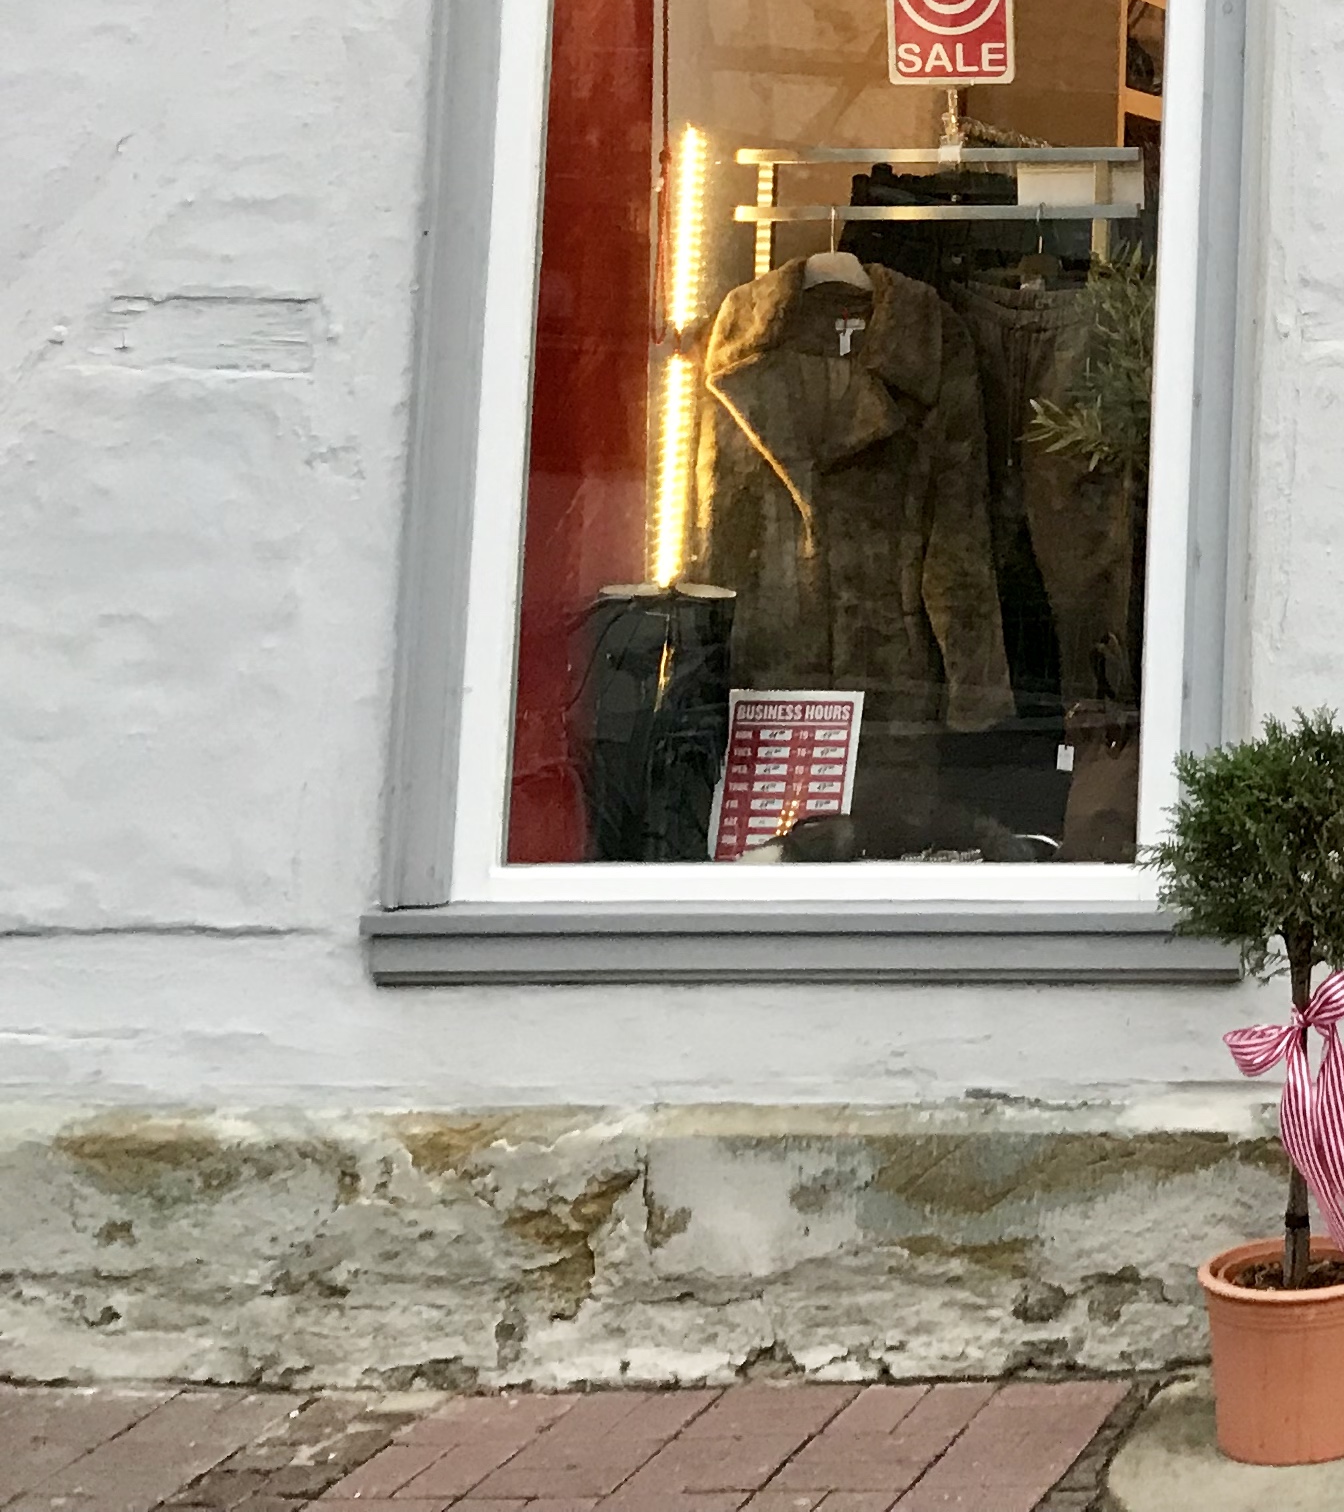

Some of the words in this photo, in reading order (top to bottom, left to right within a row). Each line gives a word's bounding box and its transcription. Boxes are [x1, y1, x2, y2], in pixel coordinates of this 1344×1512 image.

[897, 42, 1007, 73] SALE
[736, 704, 803, 721] BUSINESS
[805, 704, 851, 721] HOURS
